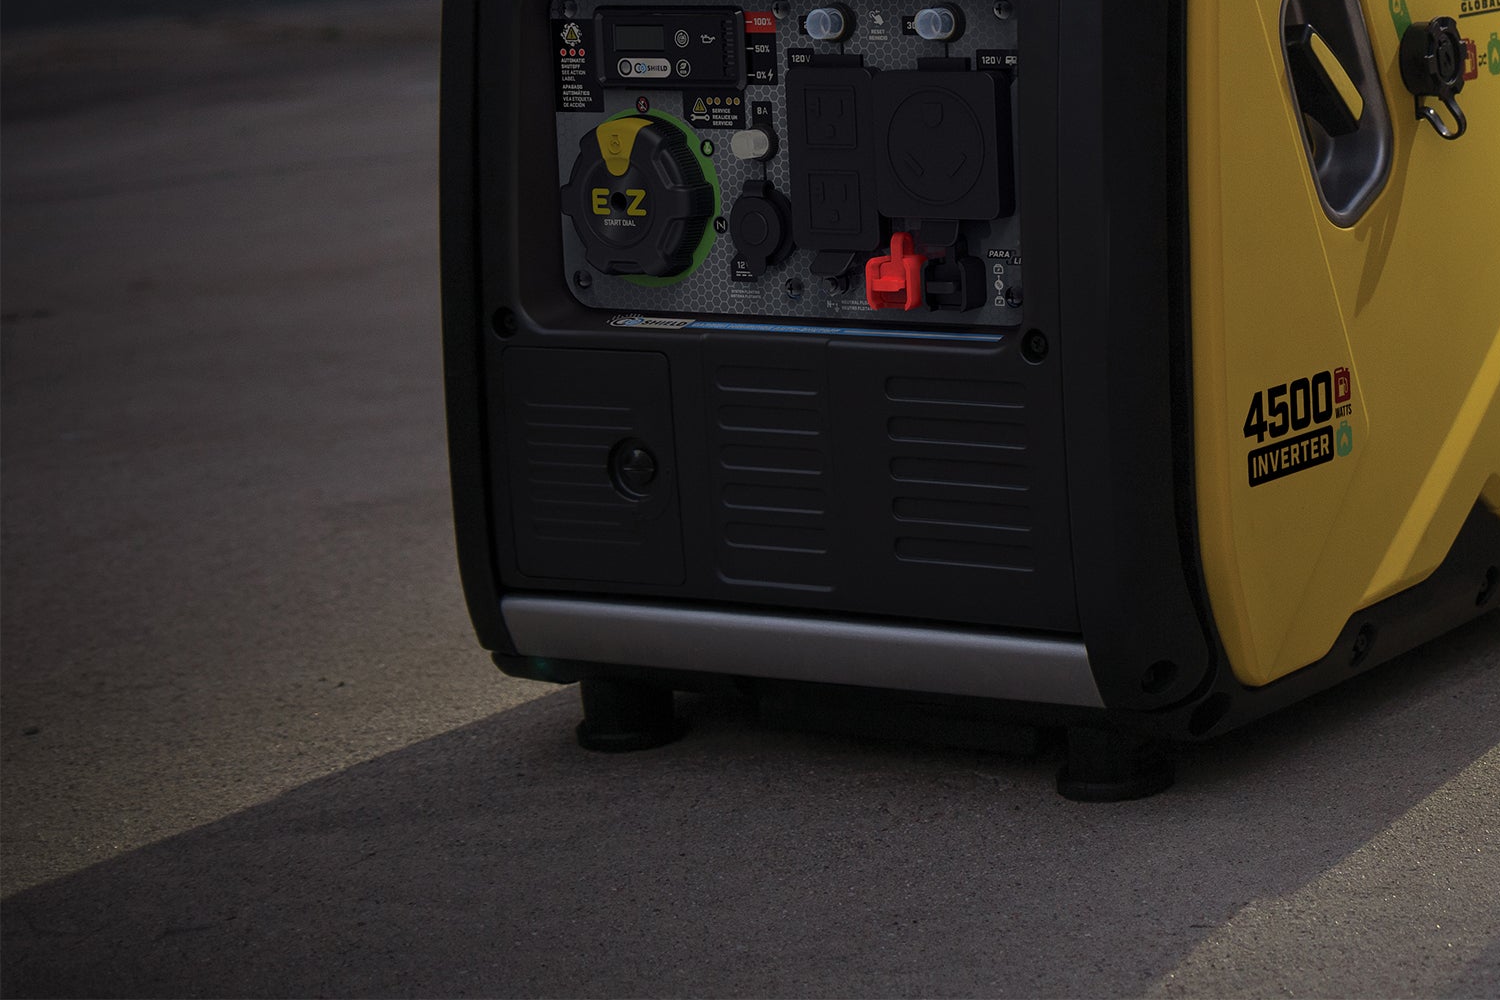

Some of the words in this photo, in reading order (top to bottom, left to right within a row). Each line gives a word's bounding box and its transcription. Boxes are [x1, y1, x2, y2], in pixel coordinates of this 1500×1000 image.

[753, 17, 772, 26] 100%
[754, 44, 770, 53] 50%
[981, 55, 1002, 65] 120V
[647, 65, 668, 73] SHIELD
[756, 71, 767, 79] 0%
[604, 218, 622, 227] START
[622, 219, 636, 228] DIAL
[988, 250, 1010, 258] PARA
[642, 319, 687, 327] SHIELD
[1243, 370, 1333, 443] 4500
[1335, 403, 1352, 419] WATTS
[1252, 433, 1330, 479] INVERTER
